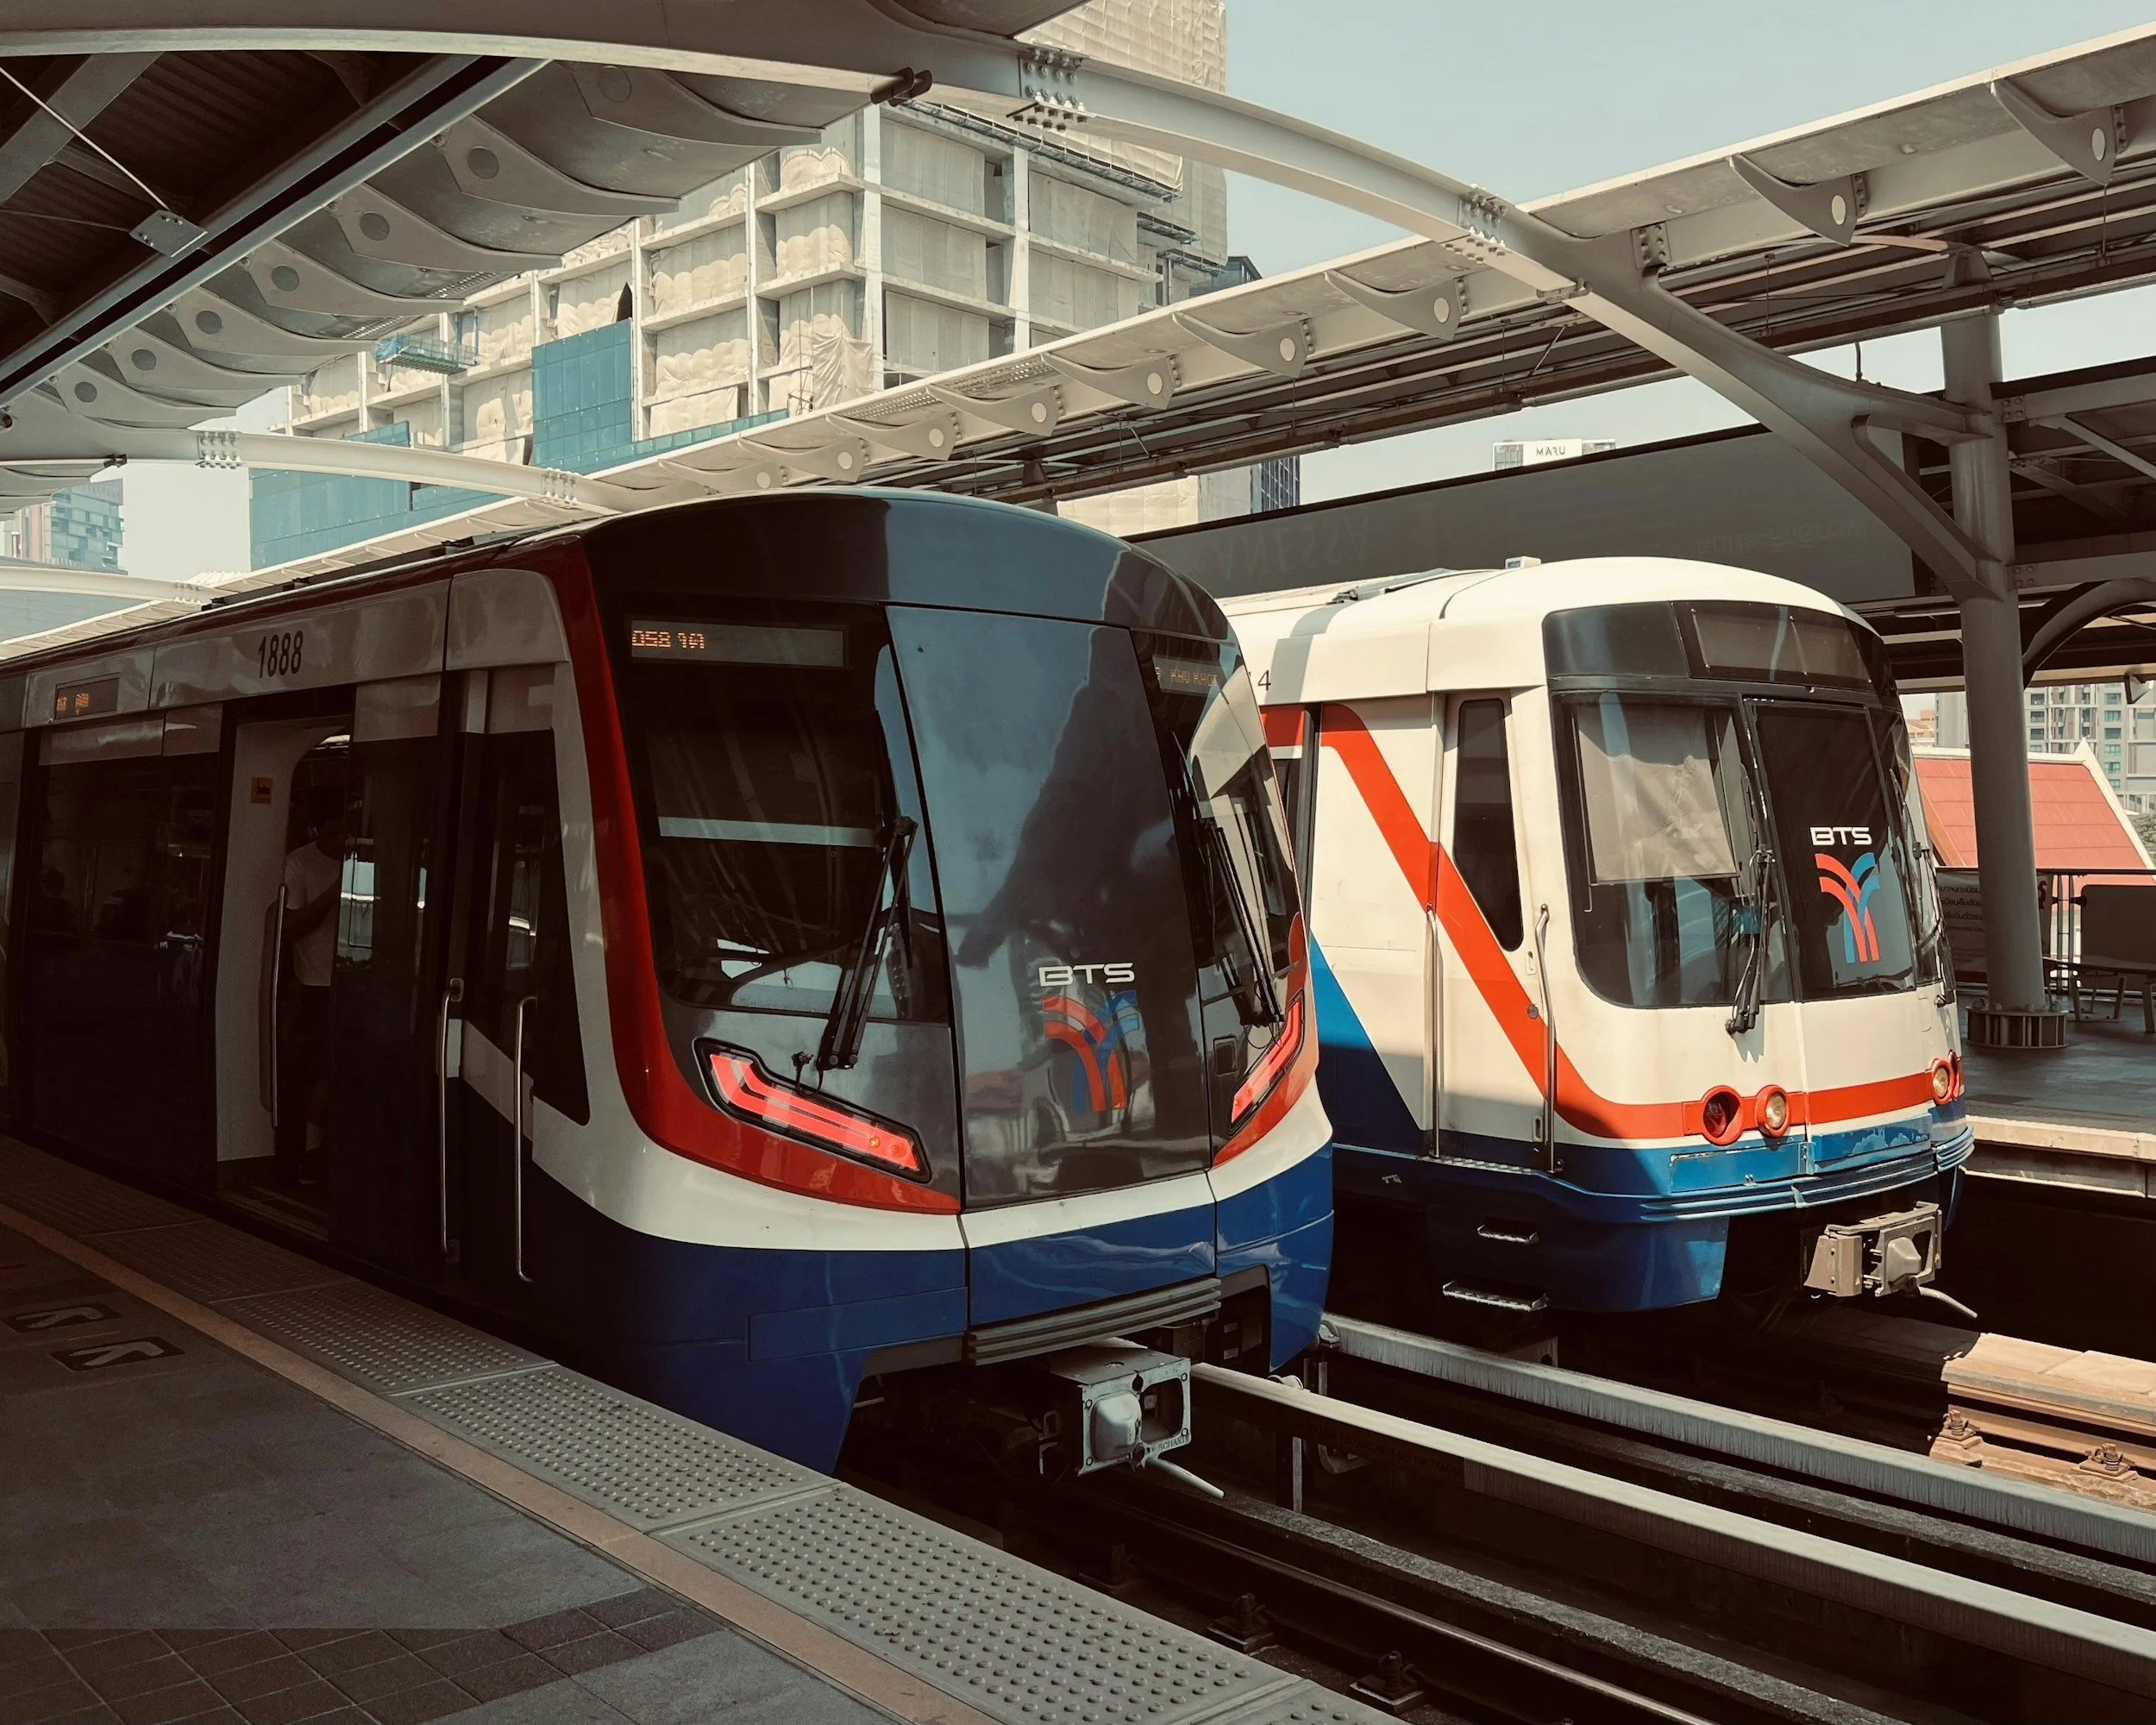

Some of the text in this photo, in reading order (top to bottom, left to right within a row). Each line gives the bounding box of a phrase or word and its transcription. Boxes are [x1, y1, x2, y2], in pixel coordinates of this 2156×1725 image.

[1536, 446, 1566, 456] MARU
[257, 630, 304, 679] 1888
[1810, 825, 1872, 846] BTS
[1038, 962, 1135, 987] BTS
